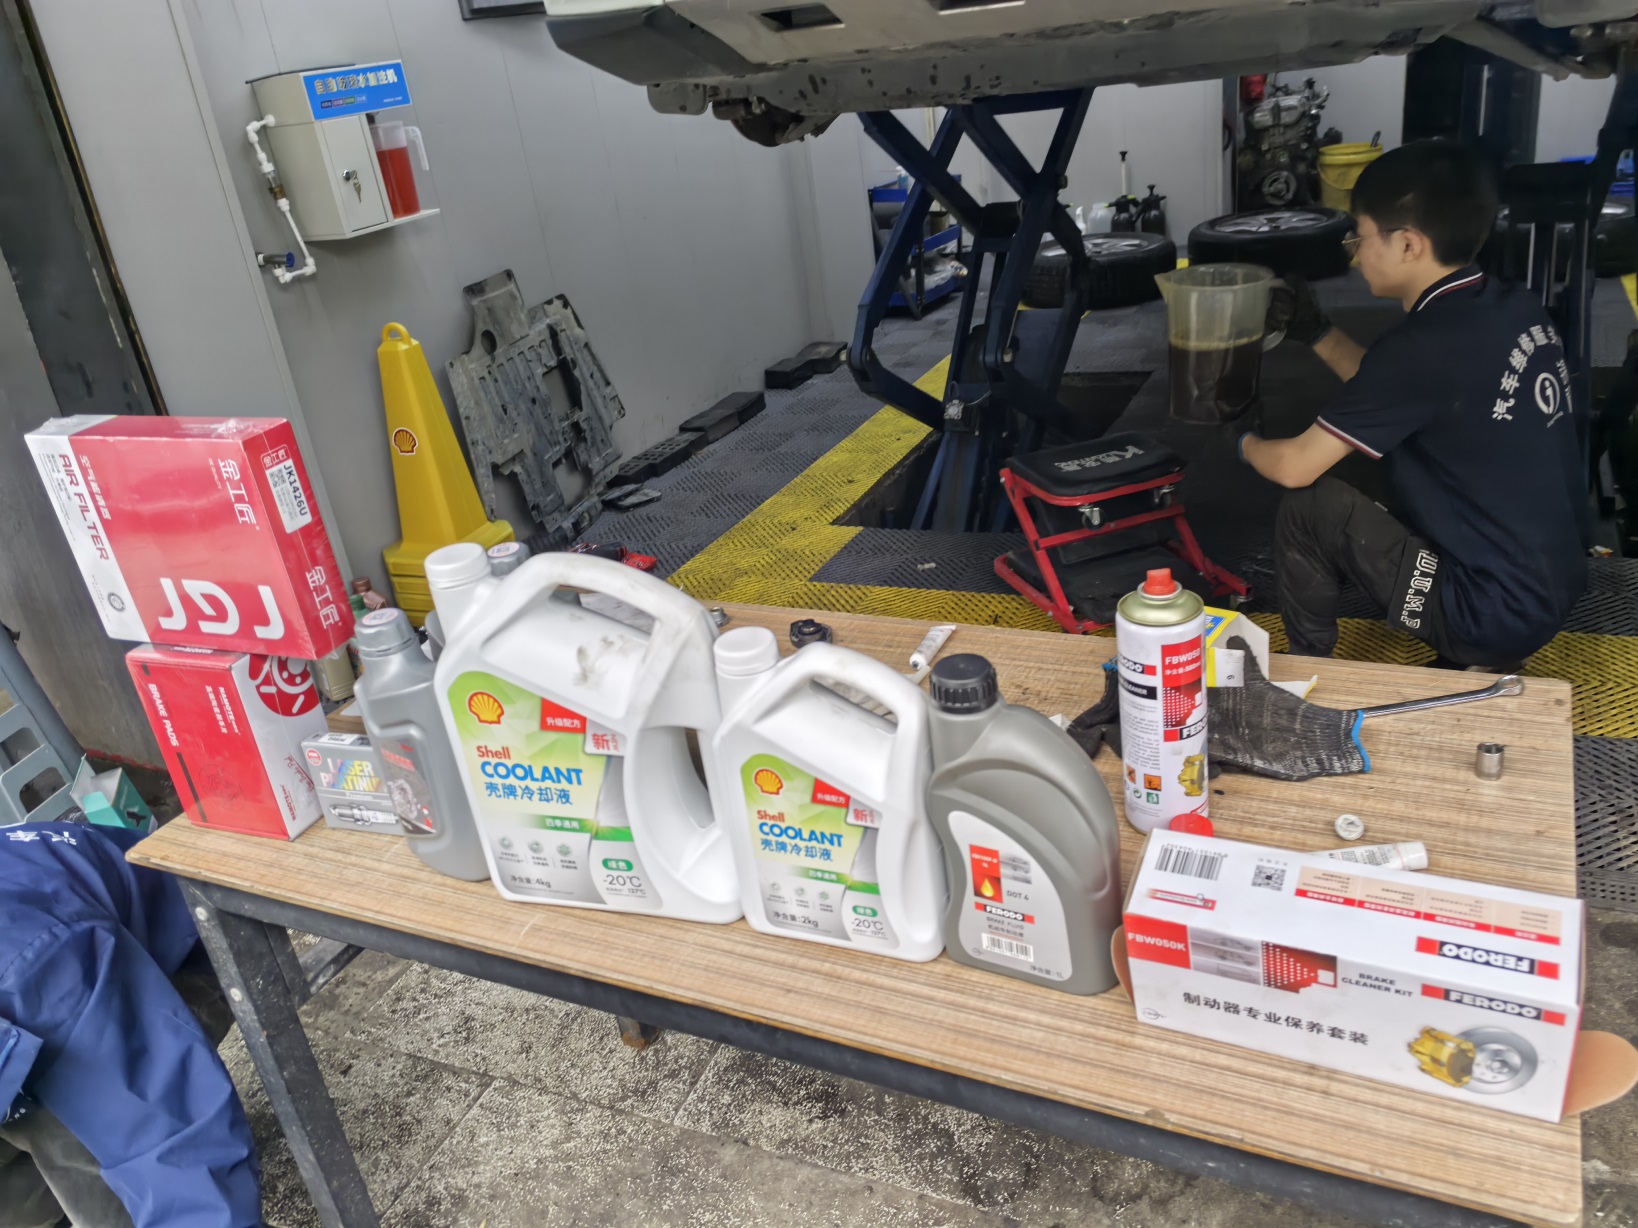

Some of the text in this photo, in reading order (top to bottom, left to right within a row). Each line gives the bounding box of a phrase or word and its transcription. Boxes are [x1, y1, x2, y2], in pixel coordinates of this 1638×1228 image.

[217, 458, 257, 525] 金工匠
[283, 463, 308, 516] JK1426U
[58, 453, 80, 487] AIR
[73, 492, 110, 561] FILTER
[305, 565, 340, 629] 金工匠
[148, 682, 180, 748] BRAKE PADS
[218, 686, 236, 722] NAMOTE
[476, 745, 511, 760] Shell
[327, 758, 374, 777] LASER
[480, 760, 583, 787] COOLANT
[484, 781, 573, 805] 壳牌冷却液
[757, 809, 786, 823] Shell
[759, 822, 844, 848] COOLANT
[761, 837, 833, 862] 壳牌冷却液
[1006, 890, 1030, 901] DOT 4
[985, 905, 1024, 921] FERODO
[1127, 931, 1187, 953] FBW050K
[1441, 943, 1531, 973] FERODO
[1341, 977, 1414, 999] CLEANER KIT
[1359, 972, 1396, 986] BRAKE
[1449, 989, 1538, 1020] FERODO
[1182, 991, 1370, 1046] 制动器专业保养套装
